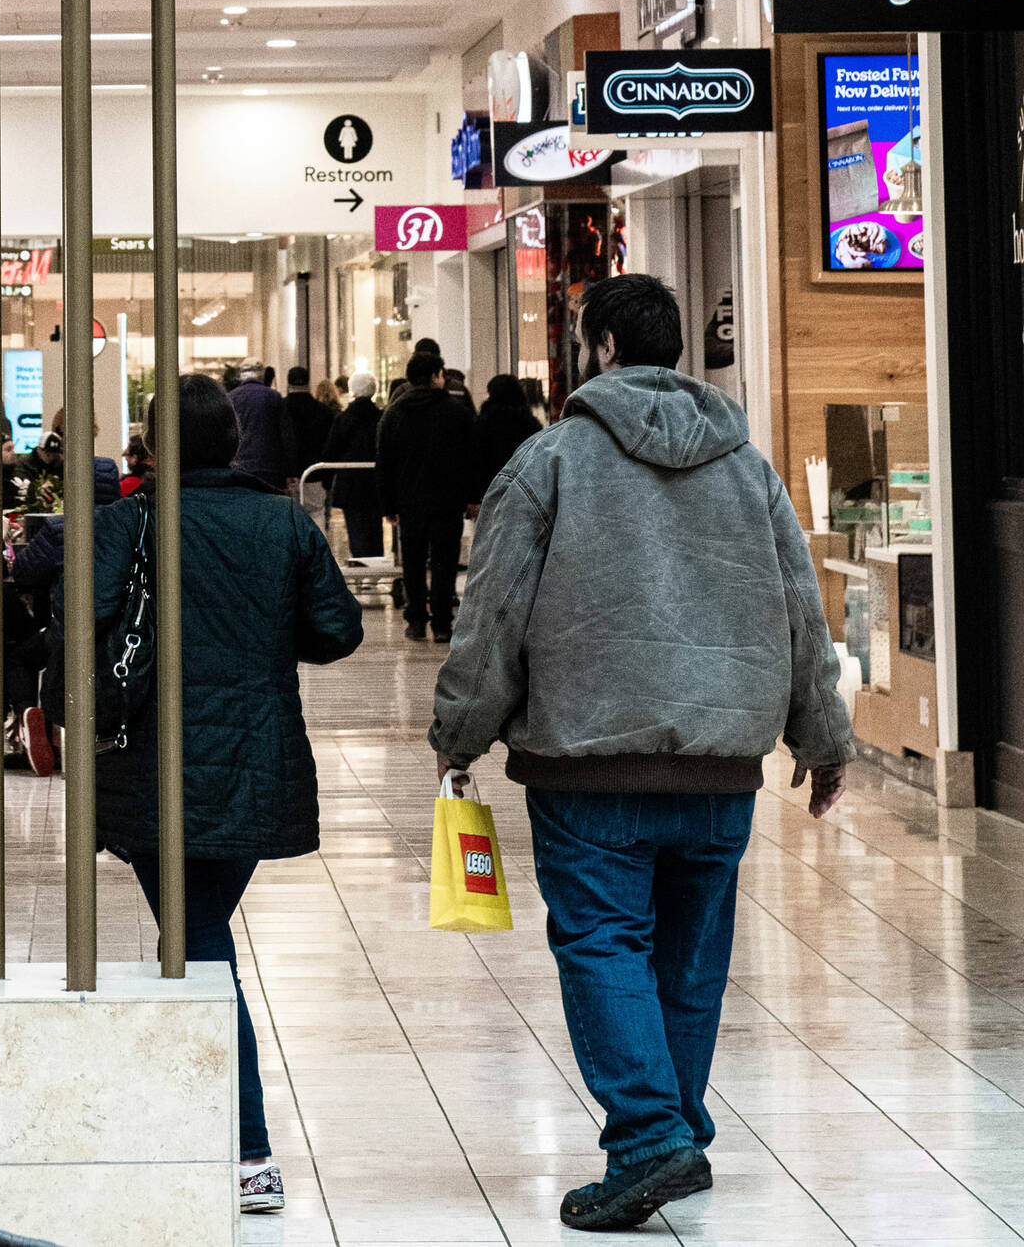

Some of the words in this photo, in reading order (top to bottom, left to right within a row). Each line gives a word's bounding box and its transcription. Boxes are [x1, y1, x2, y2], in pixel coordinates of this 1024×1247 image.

[836, 67, 890, 82] Frosted
[616, 80, 742, 103] CINNABON
[834, 84, 868, 99] Now
[304, 167, 394, 184] Restroom
[110, 237, 145, 250] Sears
[465, 851, 493, 876] LEGO
